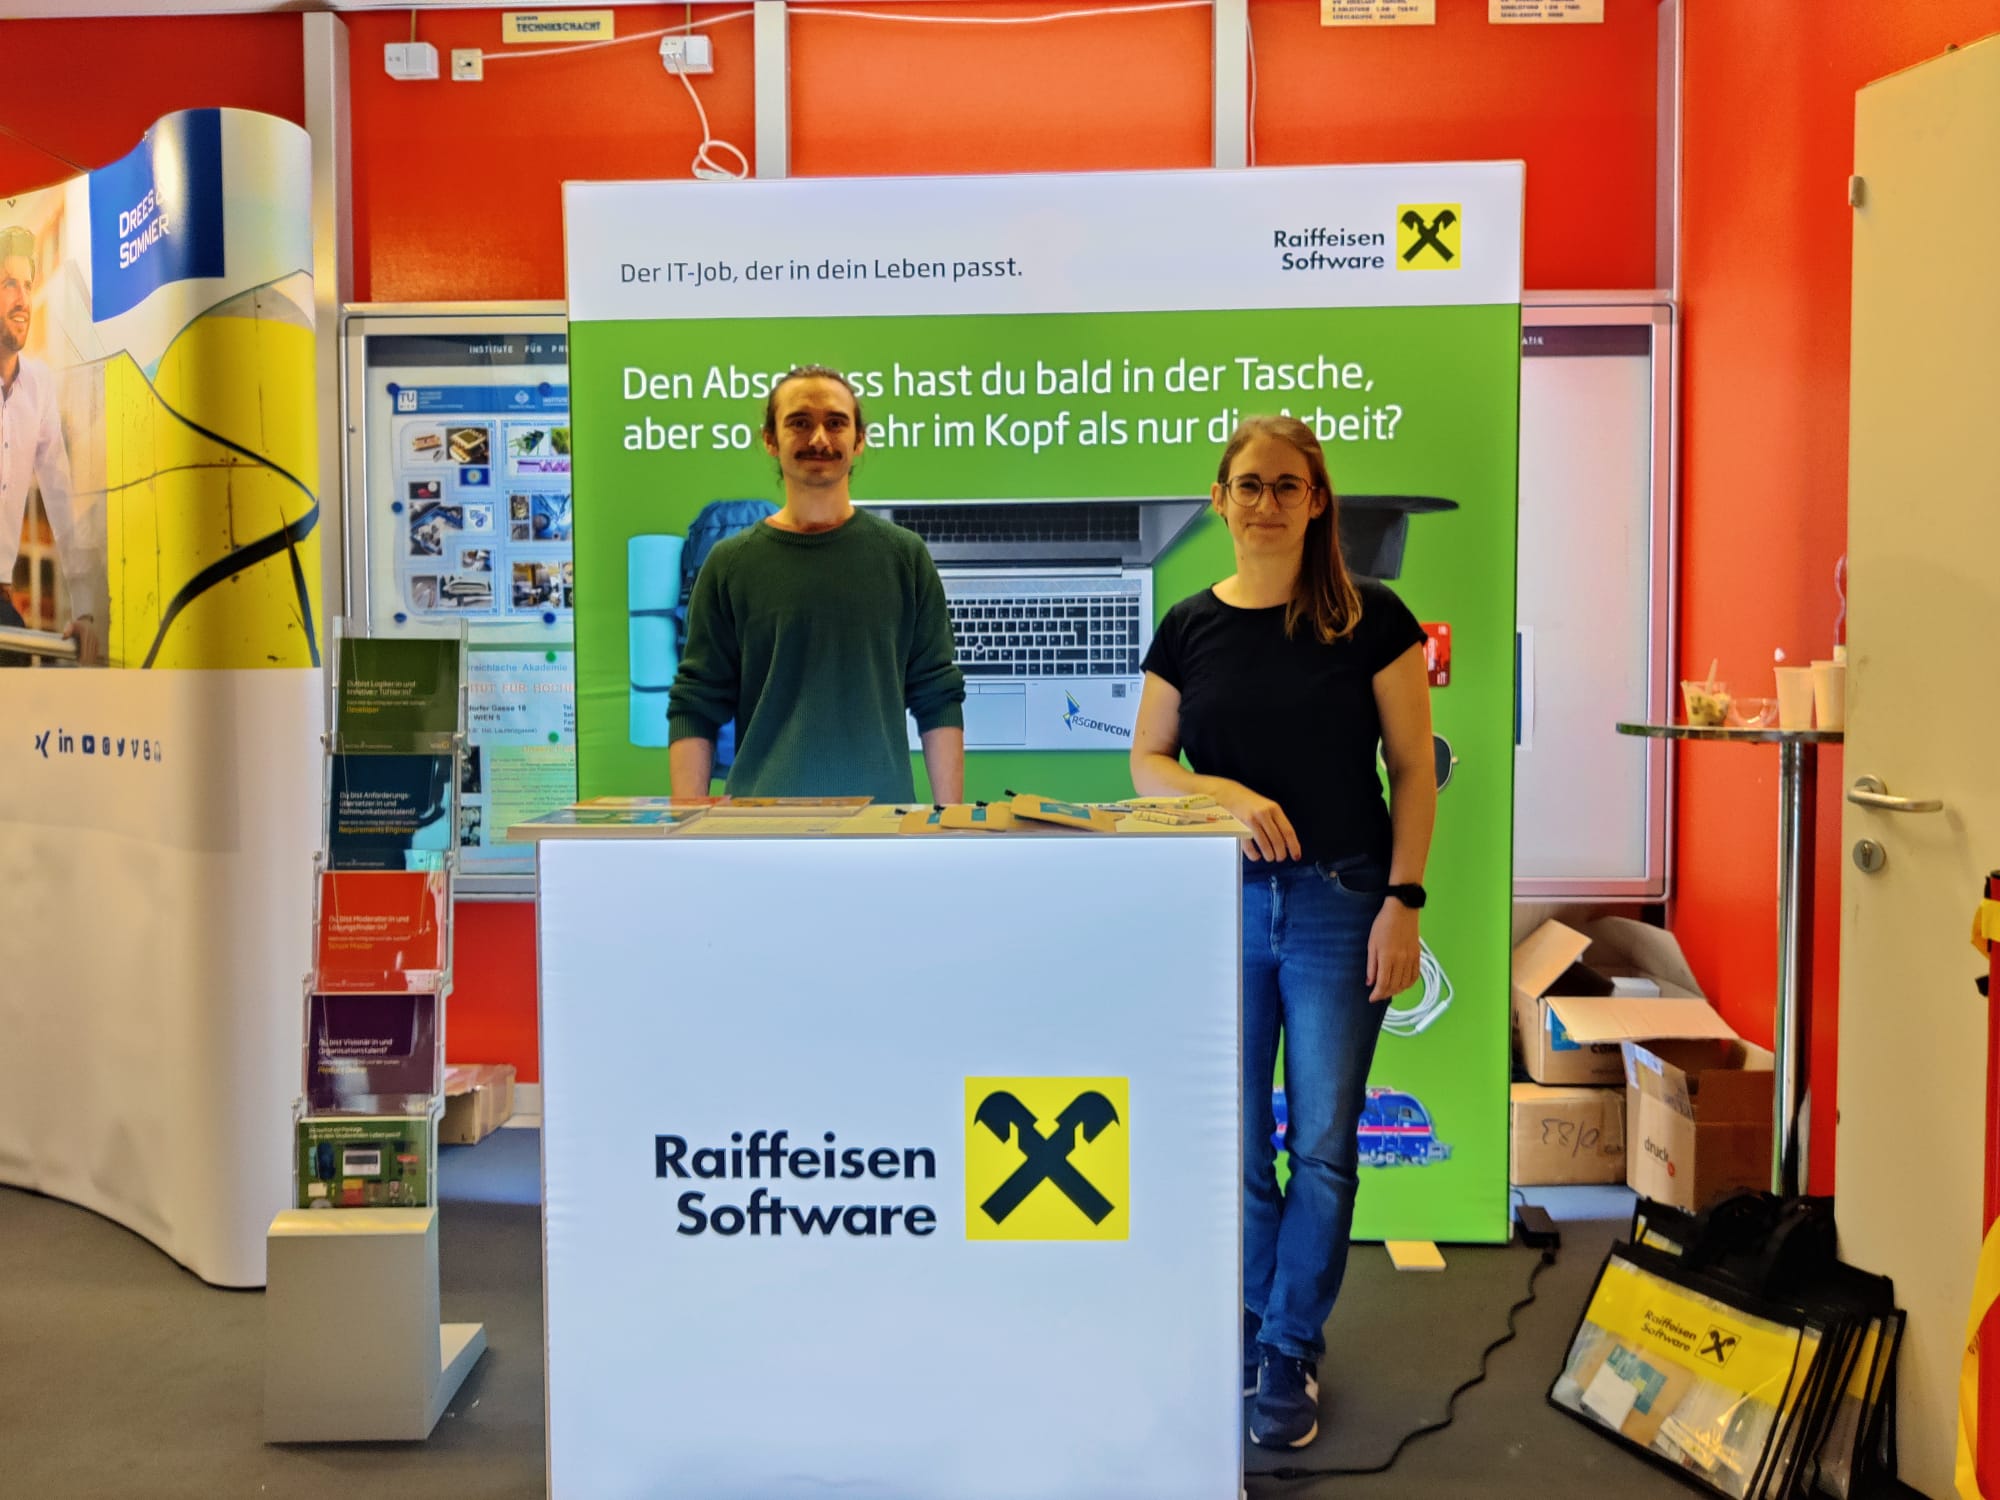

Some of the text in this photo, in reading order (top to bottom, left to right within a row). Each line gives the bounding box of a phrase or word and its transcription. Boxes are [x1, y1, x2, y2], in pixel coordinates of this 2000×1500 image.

[119, 188, 154, 239] DREES
[119, 214, 170, 269] SOMMER
[1273, 228, 1385, 249] Raiffeisen
[621, 258, 1023, 287] Der IT-Job, der in dein Leben passt.
[1281, 252, 1385, 271] Software
[624, 367, 694, 400] Den
[895, 362, 972, 397] hast
[982, 361, 1025, 397] du
[1037, 360, 1112, 395] bald
[1123, 359, 1154, 393] in
[1165, 358, 1226, 392] der
[1235, 355, 1375, 394] Tasche,
[624, 417, 703, 450] aber
[711, 425, 752, 450] so
[933, 414, 974, 447] im
[985, 411, 1070, 453] Kopf
[1079, 411, 1128, 446] als
[1138, 415, 1200, 444] nur
[1071, 715, 1132, 738] RSGDEVCON
[379, 1038, 393, 1046] und
[655, 1129, 937, 1180] Raiffeisen
[676, 1187, 937, 1237] Software
[1640, 1321, 1692, 1354] Software
[1644, 1309, 1698, 1341] Raiffeisen
